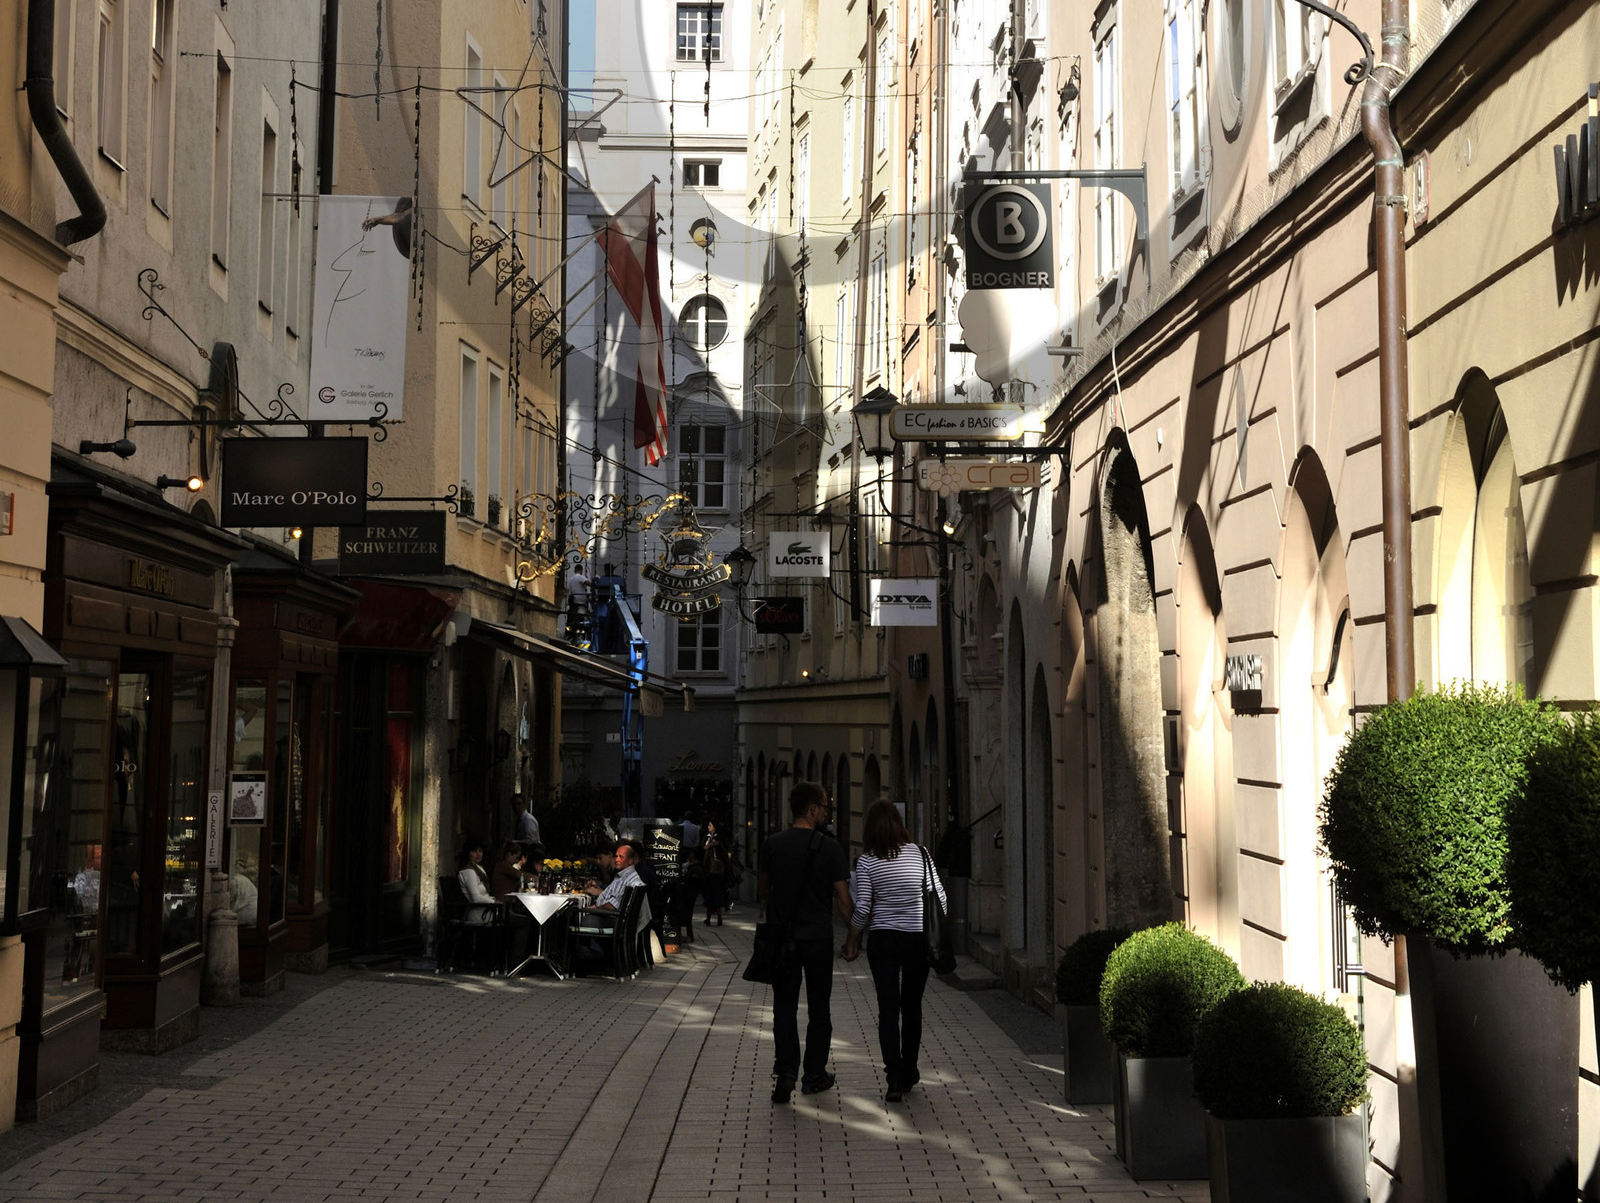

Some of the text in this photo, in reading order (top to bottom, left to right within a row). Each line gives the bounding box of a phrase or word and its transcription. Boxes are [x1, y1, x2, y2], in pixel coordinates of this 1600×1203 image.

[997, 202, 1026, 244] B
[971, 272, 1050, 286] BOGNER
[341, 389, 394, 399] Galerie Gerlich
[904, 413, 926, 427] EC
[927, 417, 957, 432] fashion
[968, 417, 1007, 428] BASIC'S
[231, 491, 357, 505] Marc O'Polo
[366, 527, 418, 539] FRANZ
[345, 541, 438, 554] SCHWEITZER
[775, 556, 823, 565] LACOSTE
[649, 569, 722, 588] RESTAURANT
[660, 598, 714, 613] HOTEL
[876, 595, 932, 603] DIVA
[210, 796, 218, 857] GALERIE
